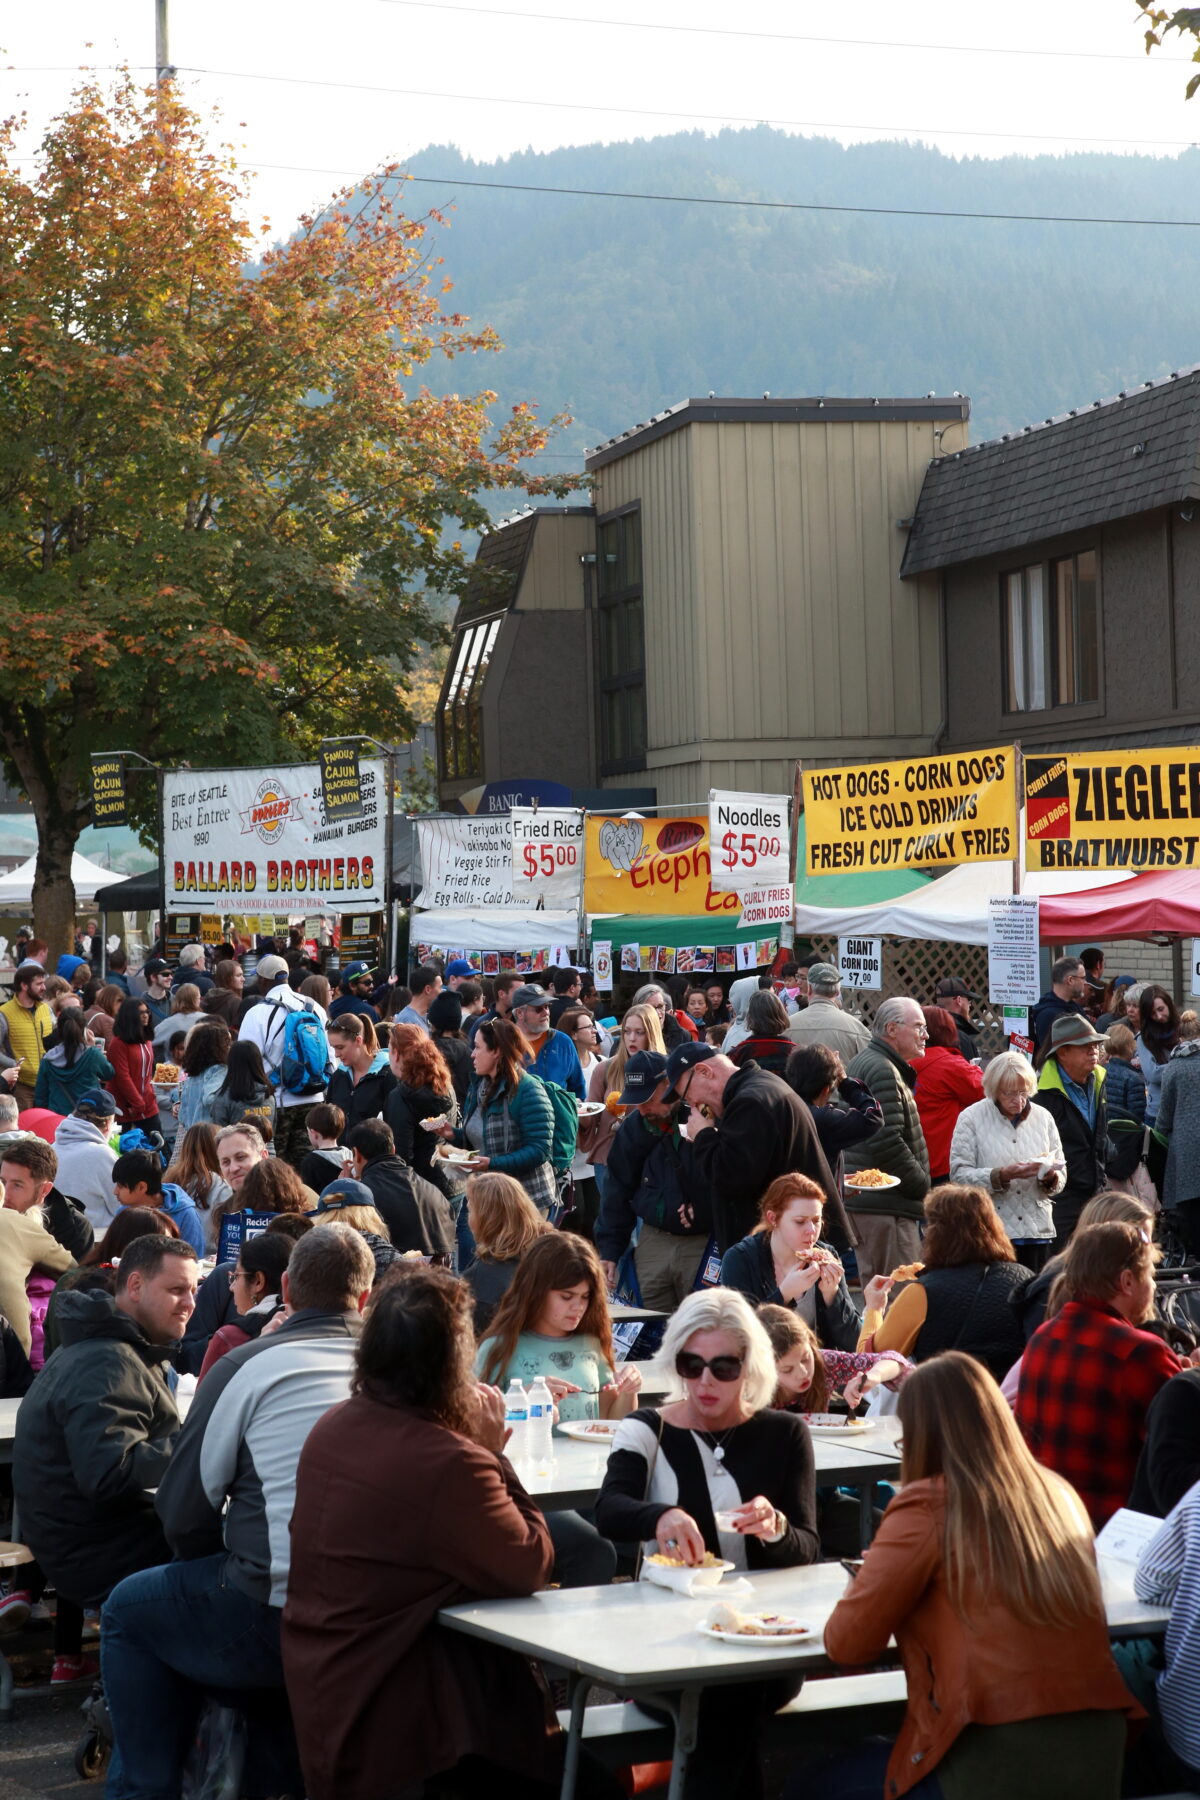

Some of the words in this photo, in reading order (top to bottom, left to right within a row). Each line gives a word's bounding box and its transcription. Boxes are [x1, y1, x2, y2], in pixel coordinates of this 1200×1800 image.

[323, 749, 354, 764] FAMOUS
[92, 763, 120, 776] FAMOUS
[325, 765, 355, 779] CAJUN
[811, 774, 841, 800] HOT
[847, 769, 890, 798] DOGS
[904, 762, 953, 792] CORN
[957, 754, 1005, 786] DOGS
[93, 778, 121, 790] CAJUN
[325, 779, 358, 791] BLACKENED
[1027, 772, 1048, 796] CURLY
[1047, 760, 1067, 782] FRIES
[93, 790, 125, 801] BLACKENED
[171, 794, 185, 808] BITE
[188, 792, 196, 805] of
[198, 785, 227, 803] SEATTLE
[258, 782, 281, 799] BALLARD
[326, 791, 360, 808] SALMON
[95, 801, 125, 816] SALMON
[718, 805, 781, 828] Noodles
[839, 805, 867, 832] ICE
[869, 801, 913, 830] COLD
[917, 793, 978, 826] DRINKS
[172, 811, 192, 831] Best
[197, 807, 230, 827] Entree
[1029, 815, 1049, 837] CORN
[1047, 802, 1068, 824] DOGS
[313, 827, 343, 844] HAWAIIAN
[347, 817, 378, 835] BURGERS
[467, 822, 503, 838] Teriyaki
[513, 820, 549, 838] Fried
[553, 820, 583, 837] Rice
[193, 831, 209, 846] 1990
[501, 838, 512, 851] No
[811, 841, 864, 869] FRESH
[870, 838, 903, 865] CUT
[904, 831, 956, 862] CURLY
[961, 826, 1010, 856] FRIES
[1040, 836, 1200, 868] BRATWURST
[455, 855, 482, 871] Veggie
[485, 855, 500, 868] Stir
[502, 855, 511, 867] Fr
[630, 843, 711, 893] Eleph
[174, 860, 257, 893] BALLARD
[267, 856, 374, 893] BROTHERS
[444, 874, 469, 886] Fried
[472, 874, 491, 886] Rice
[216, 899, 235, 908] CAJUN
[236, 899, 261, 909] SEAFOOD
[268, 898, 297, 909] GOURMET
[434, 892, 450, 906] Egg
[453, 891, 474, 904] Rolls
[483, 891, 503, 904] Cold
[744, 890, 766, 905] CURLY
[768, 888, 790, 901] FRIES
[1023, 900, 1037, 908] Sausage
[768, 905, 789, 918] DOGS
[202, 930, 220, 942] $5.00
[847, 939, 874, 956] GIANT
[841, 957, 861, 970] CORN
[863, 959, 879, 971] DOG
[849, 972, 871, 986] $7.00
